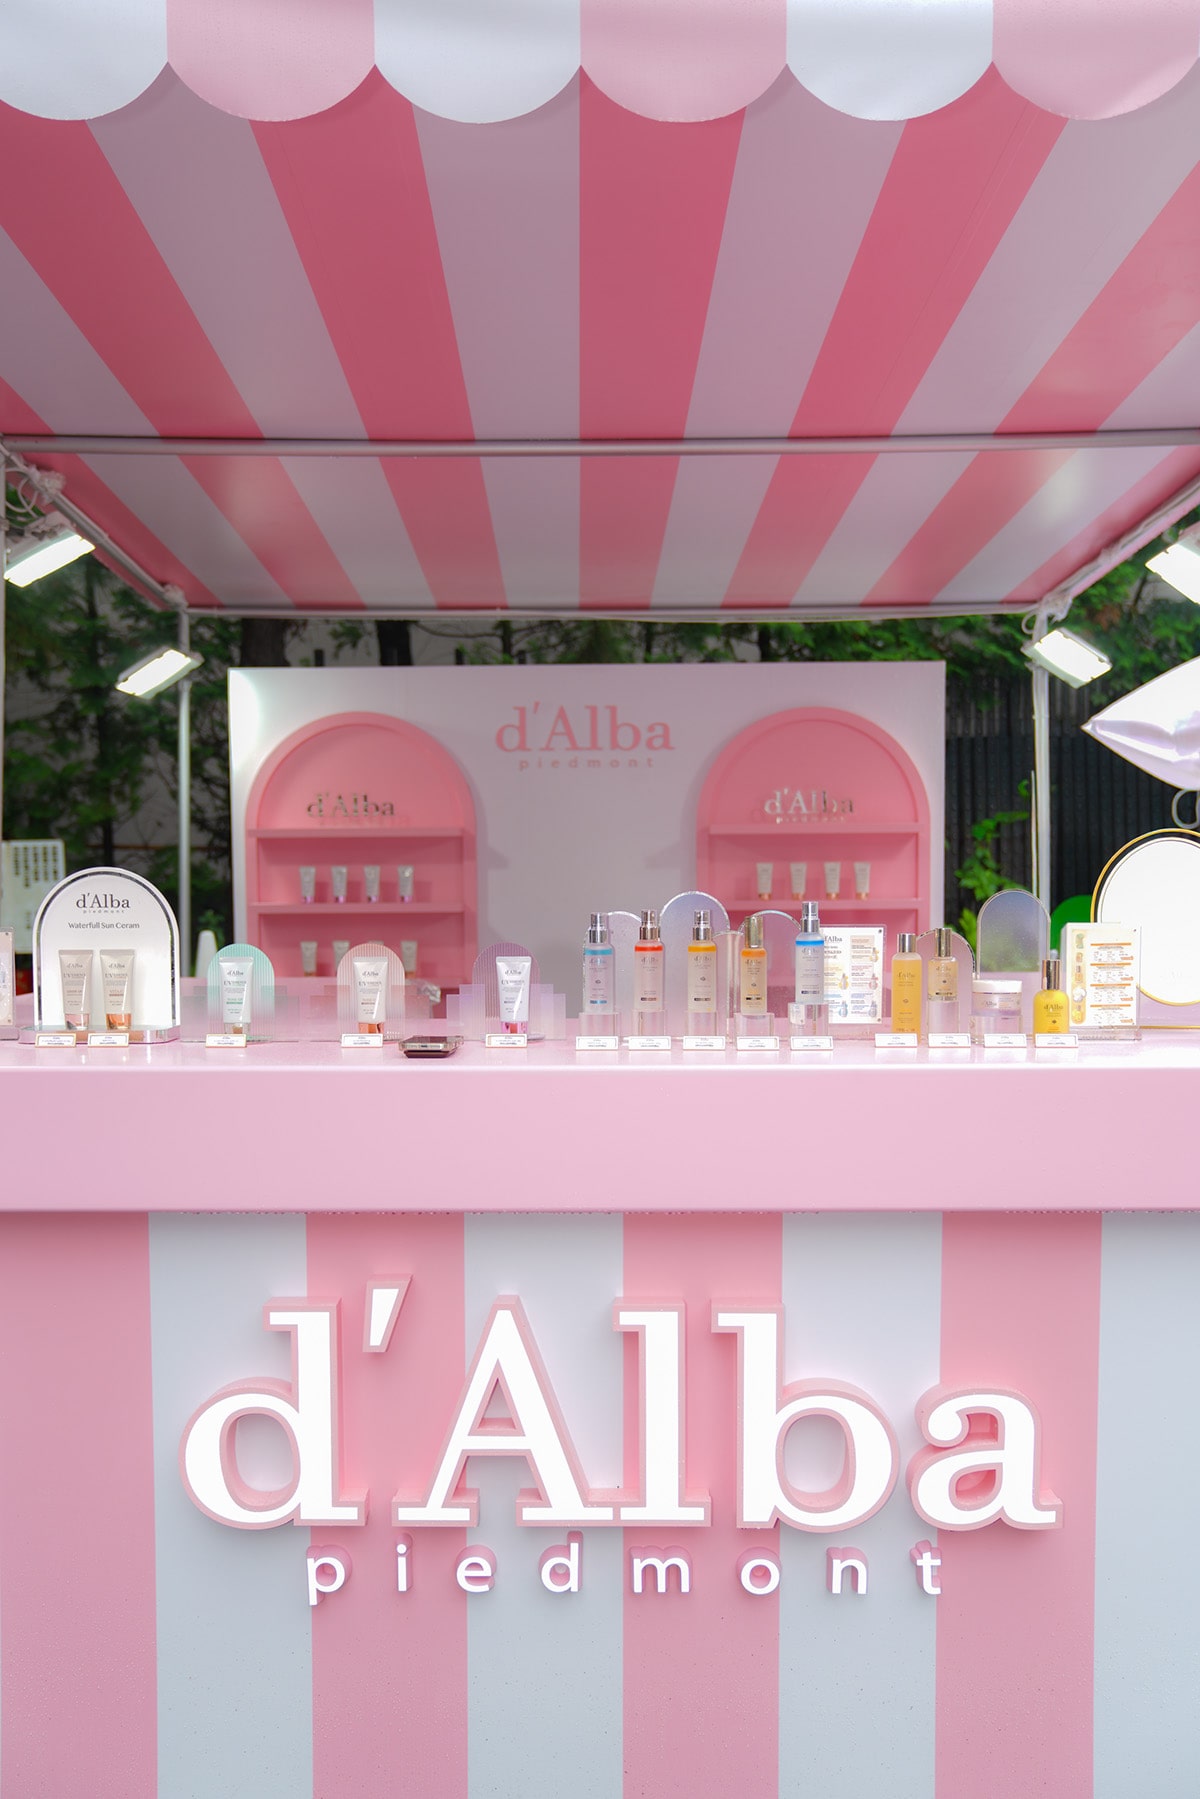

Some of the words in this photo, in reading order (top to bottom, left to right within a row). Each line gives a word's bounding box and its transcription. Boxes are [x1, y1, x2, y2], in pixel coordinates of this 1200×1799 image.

[495, 701, 676, 752] d'Alba
[518, 756, 655, 771] piedmont
[306, 791, 395, 818] d'Alba
[764, 788, 854, 814] d'Alba
[76, 892, 130, 908] d'Alba
[180, 1276, 1064, 1533] d'Alba
[306, 1534, 942, 1606] piedmont
